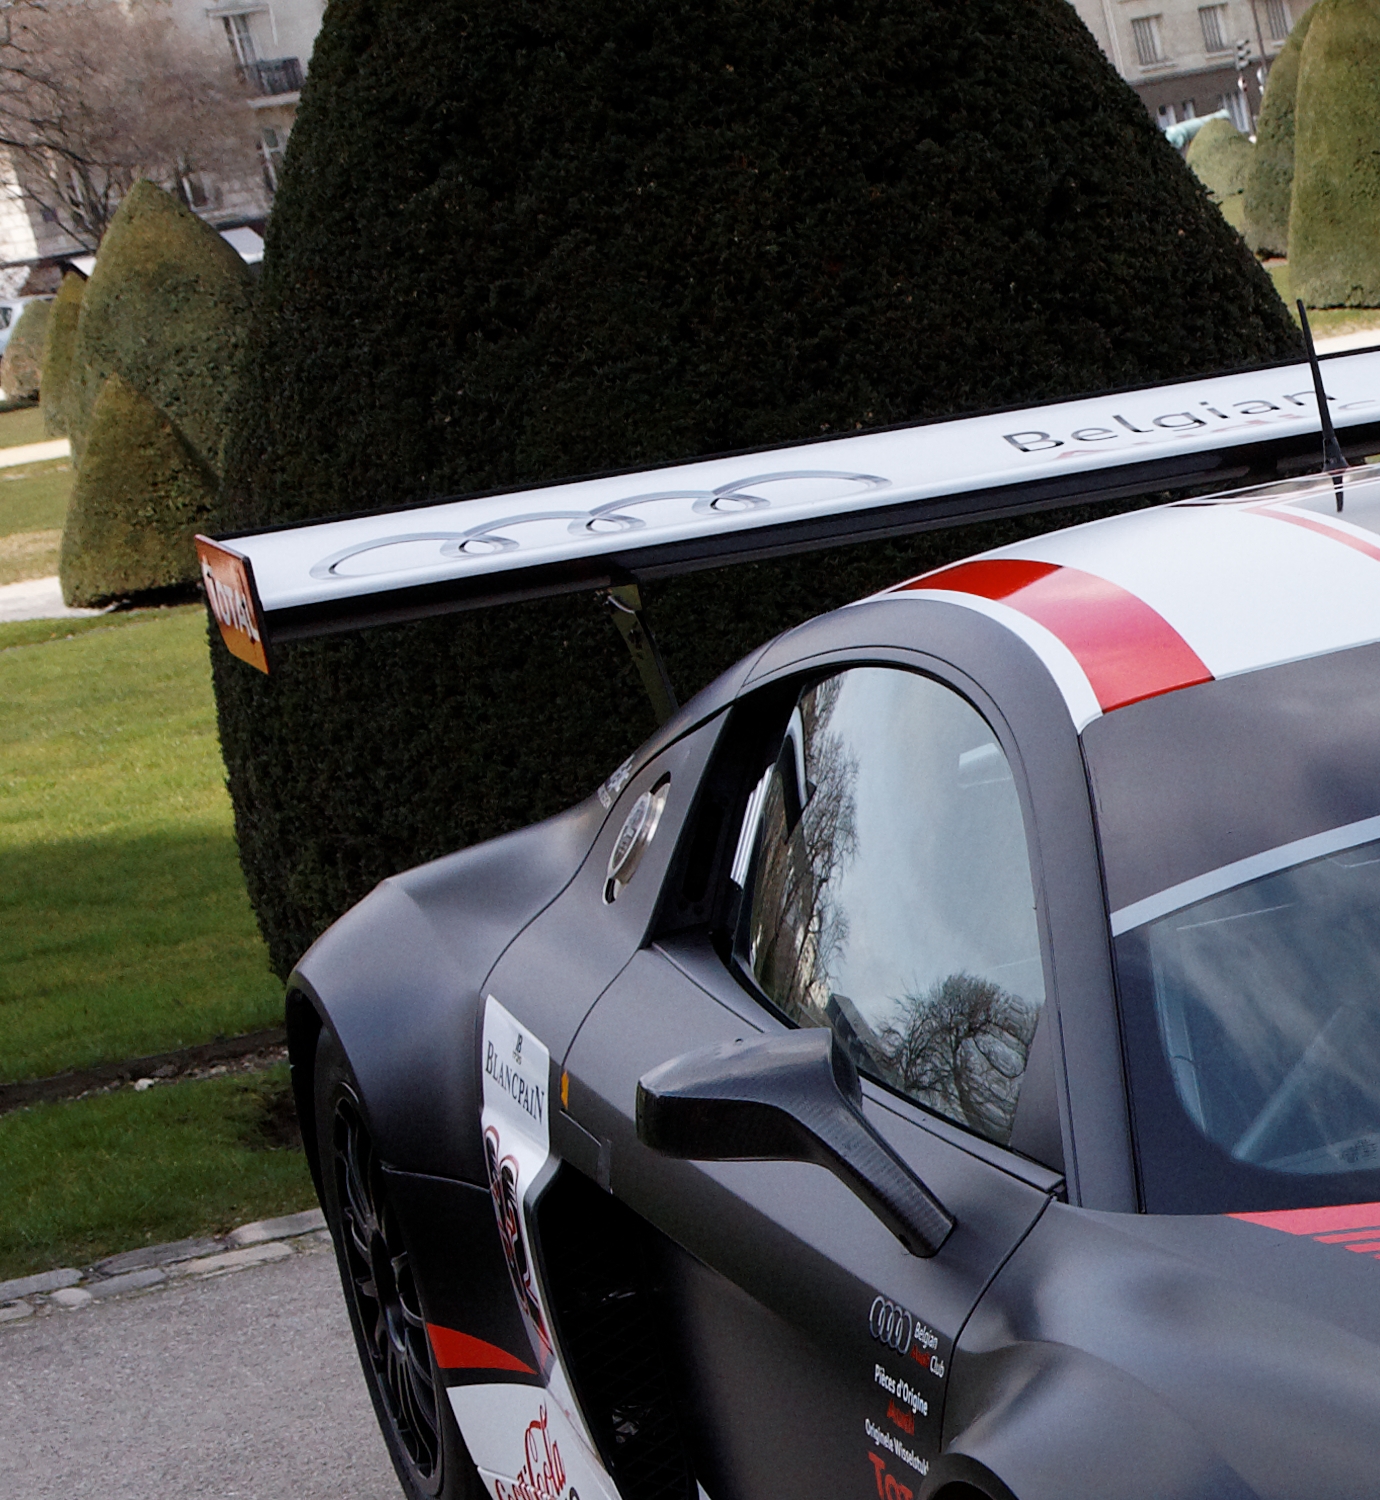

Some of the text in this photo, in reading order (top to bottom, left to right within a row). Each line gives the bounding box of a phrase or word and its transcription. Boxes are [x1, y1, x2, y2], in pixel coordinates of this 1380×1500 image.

[1002, 389, 1335, 453] Belgian
[485, 1040, 545, 1125] BLANCPAIN
[914, 1321, 938, 1350] Belgian
[929, 1355, 945, 1379] Club
[874, 1363, 928, 1417] Pièces d'Origine
[864, 1417, 895, 1452] Originele
